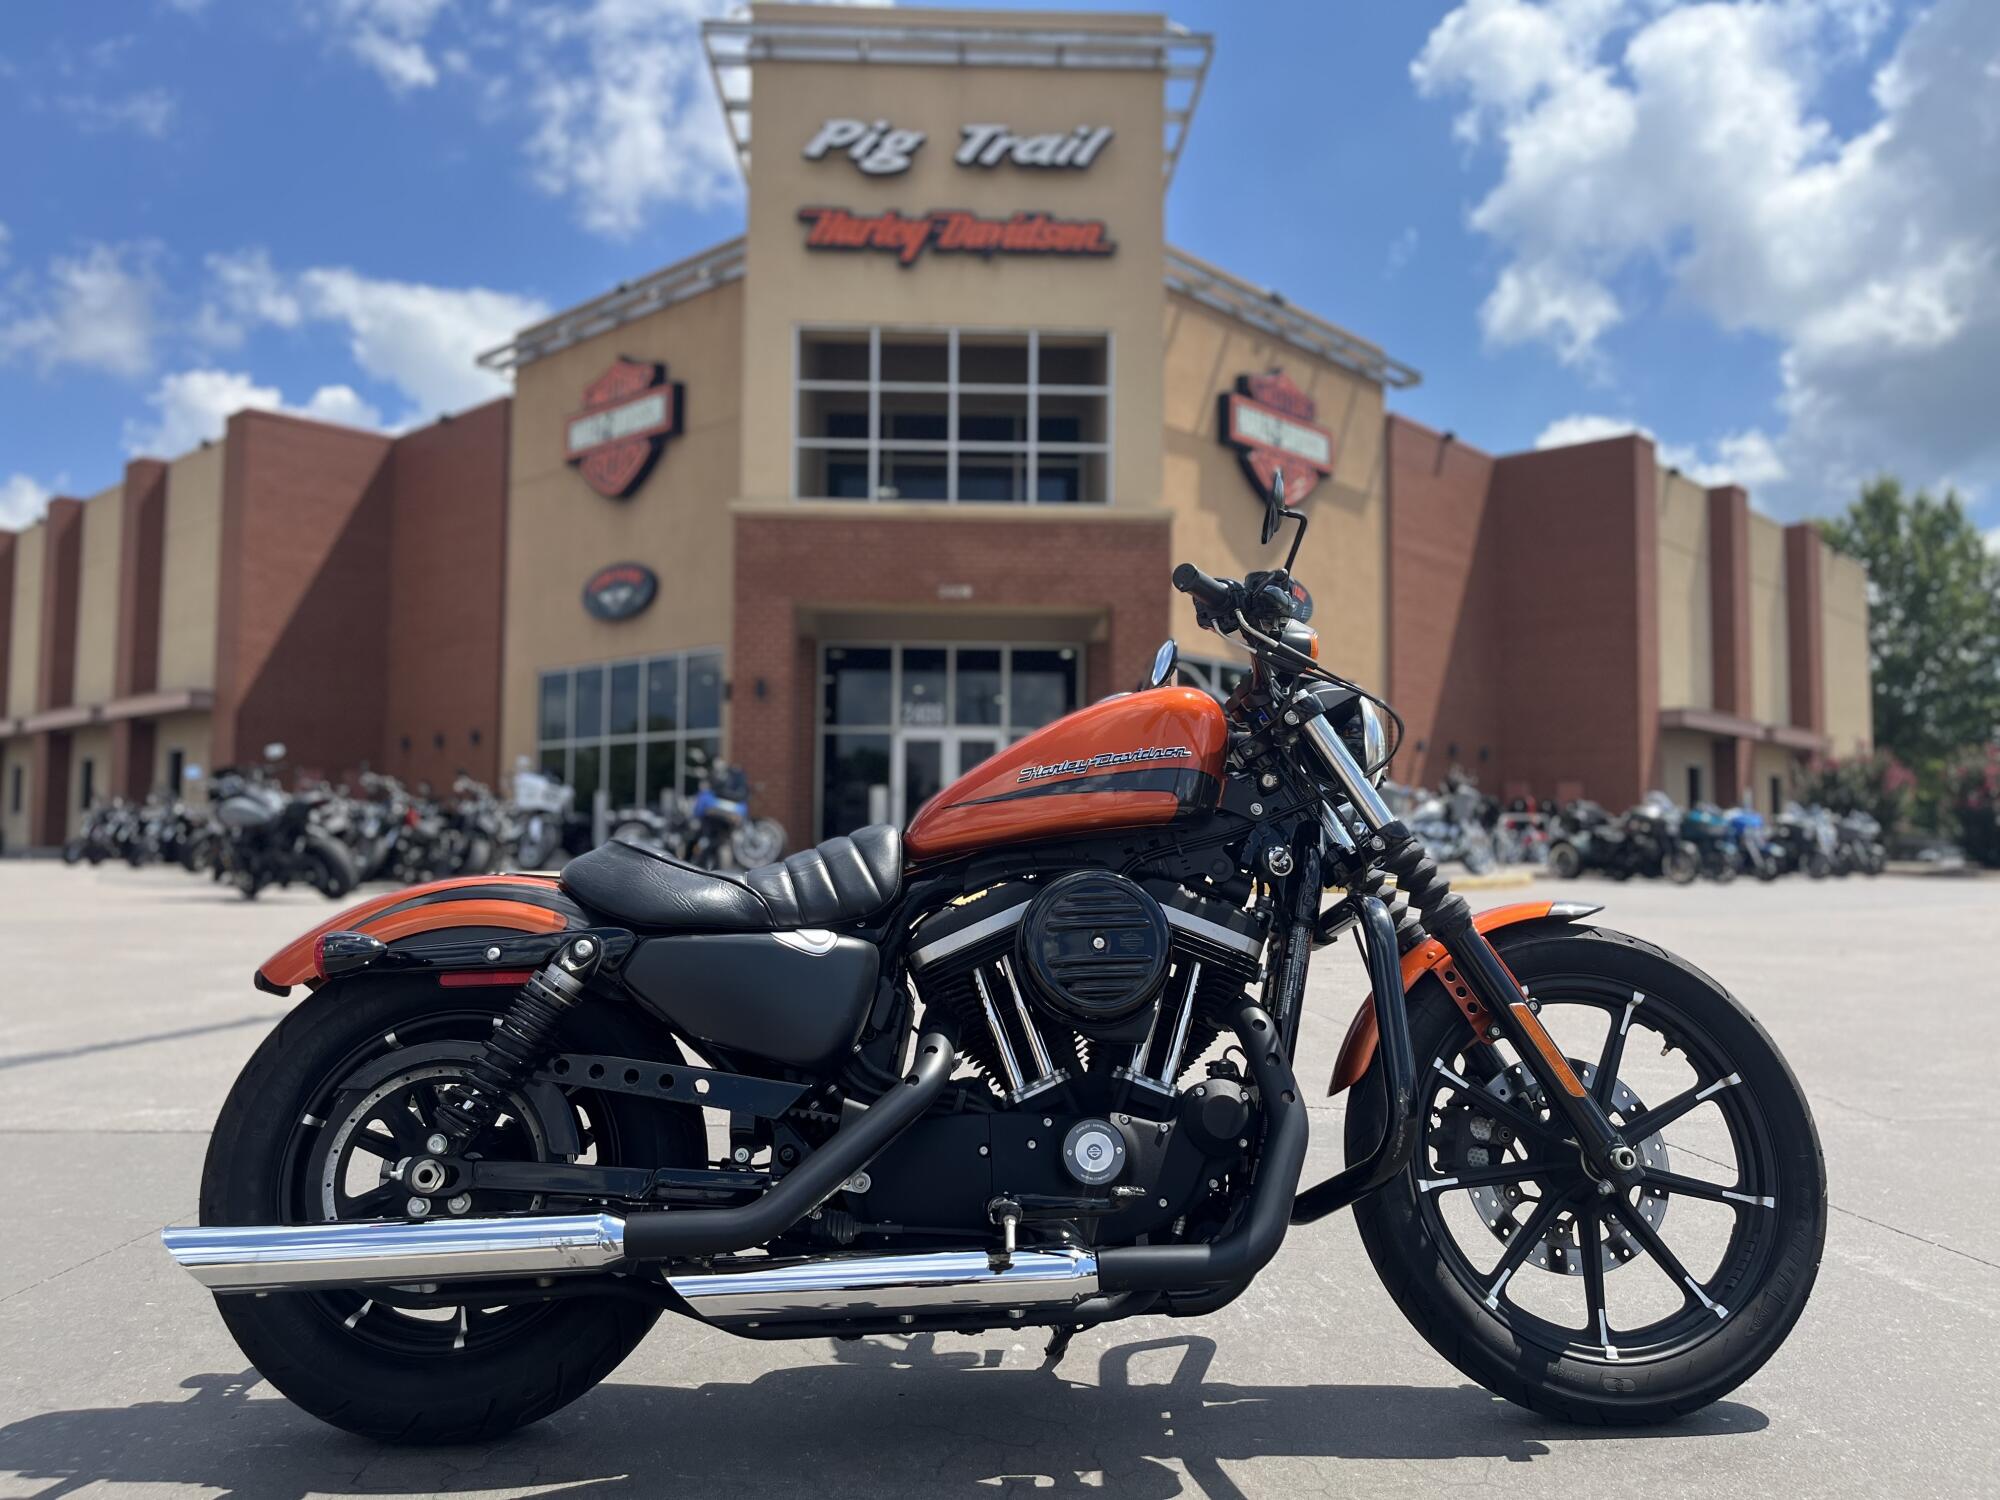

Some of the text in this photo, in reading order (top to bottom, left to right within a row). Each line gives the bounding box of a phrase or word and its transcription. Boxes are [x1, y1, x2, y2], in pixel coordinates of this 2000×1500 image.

[804, 119, 1112, 173] Pig Trail
[800, 209, 1114, 266] Harley-Davidson
[1017, 747, 1192, 783] Harley-Davidson
